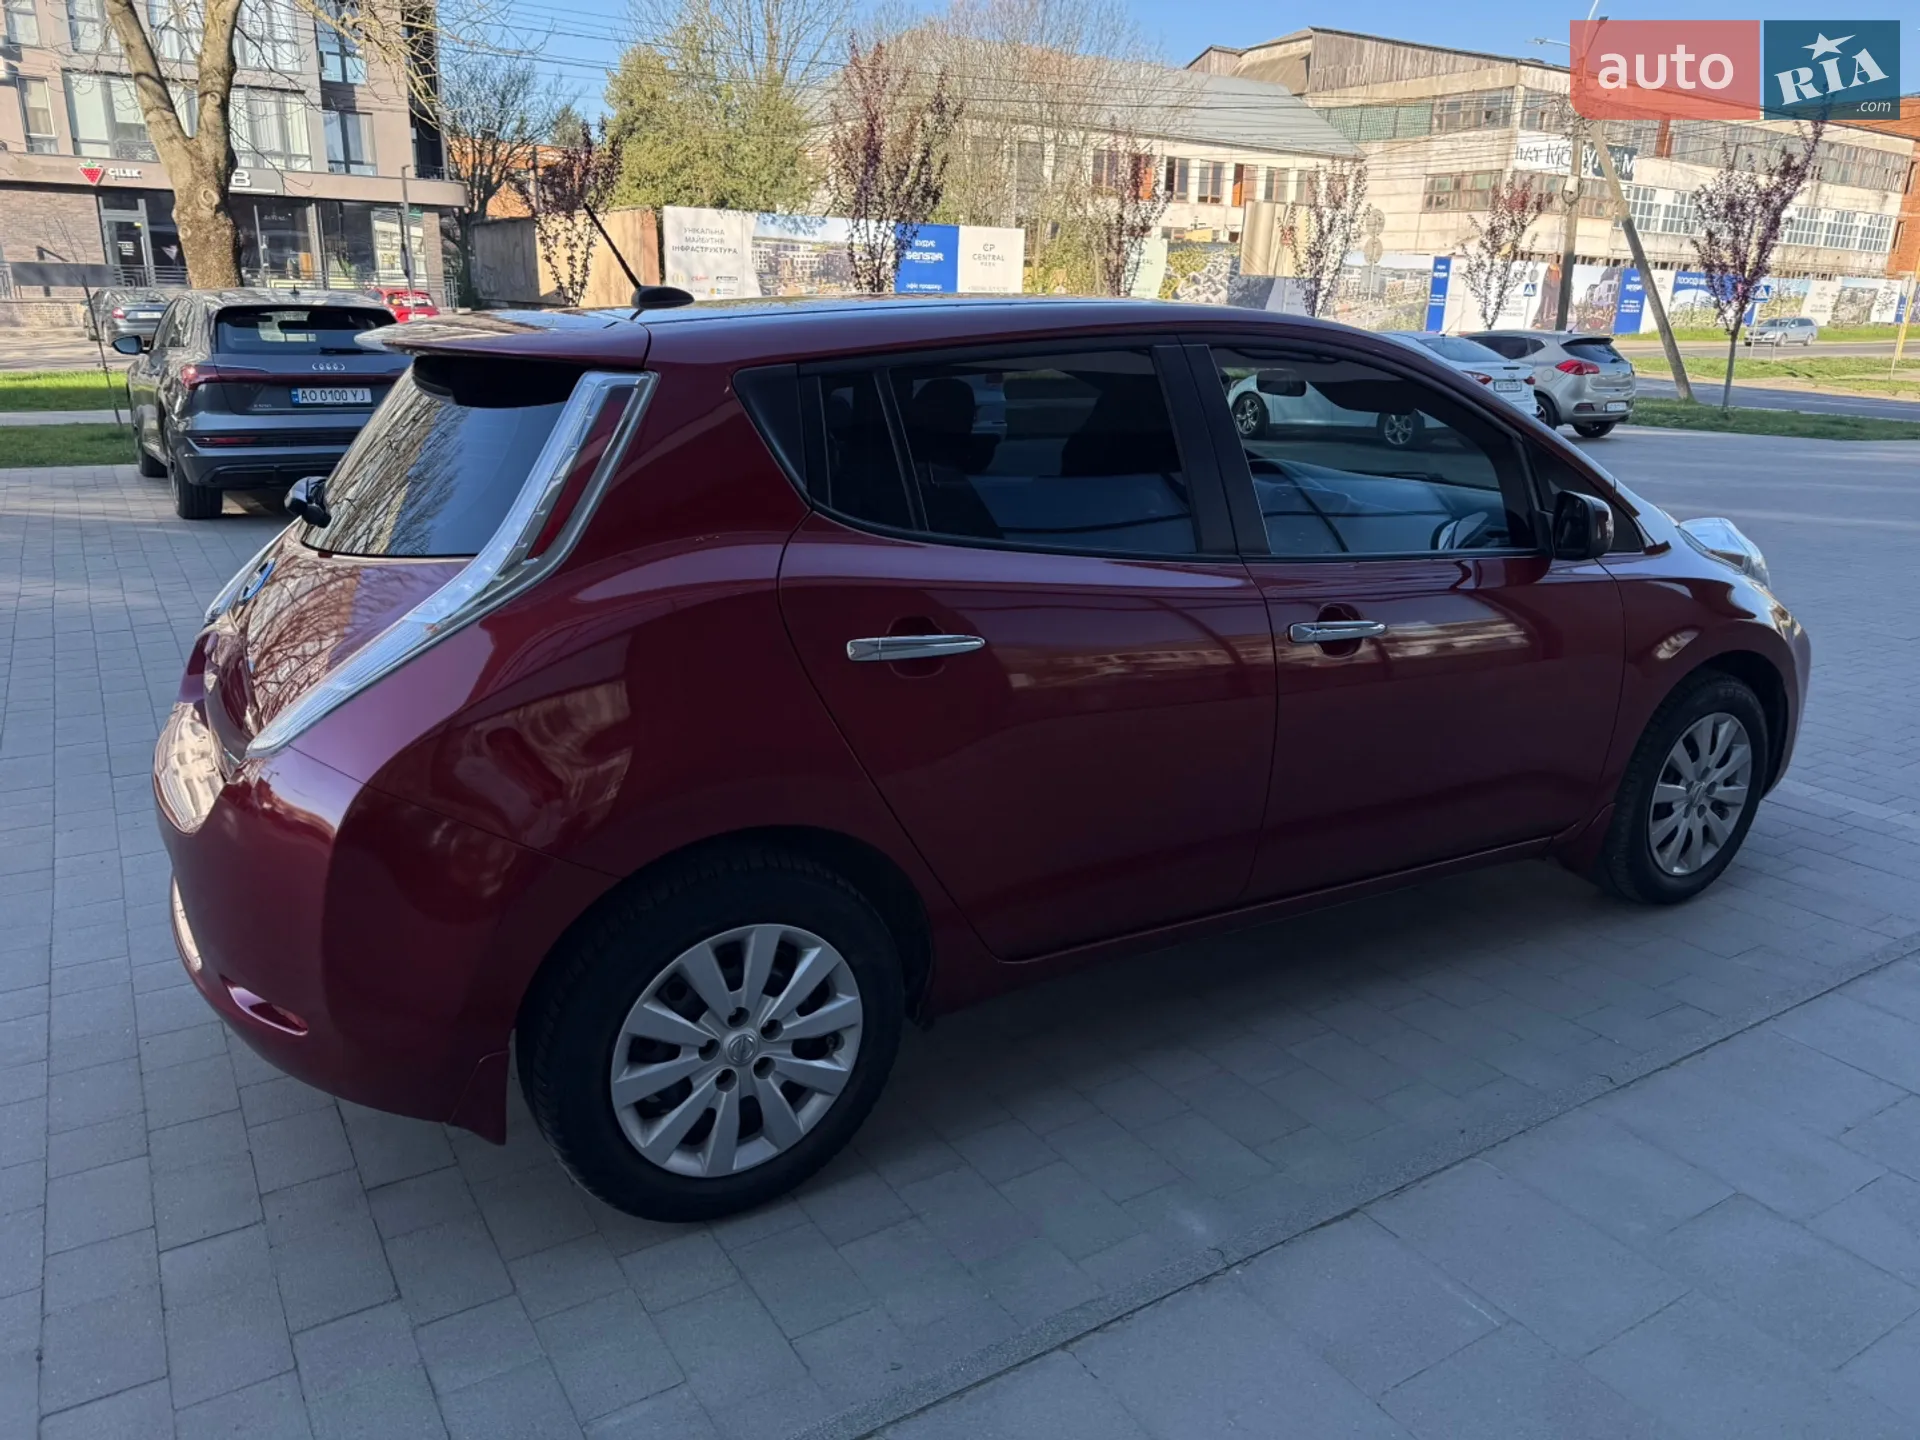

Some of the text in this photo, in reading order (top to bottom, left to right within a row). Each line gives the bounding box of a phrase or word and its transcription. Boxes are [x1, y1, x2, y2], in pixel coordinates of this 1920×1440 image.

[672, 245, 738, 254] ІНФРАСТРУКТУРА
[972, 253, 1005, 262] CENTRAL
[301, 389, 366, 401] AO 0100 YJ
